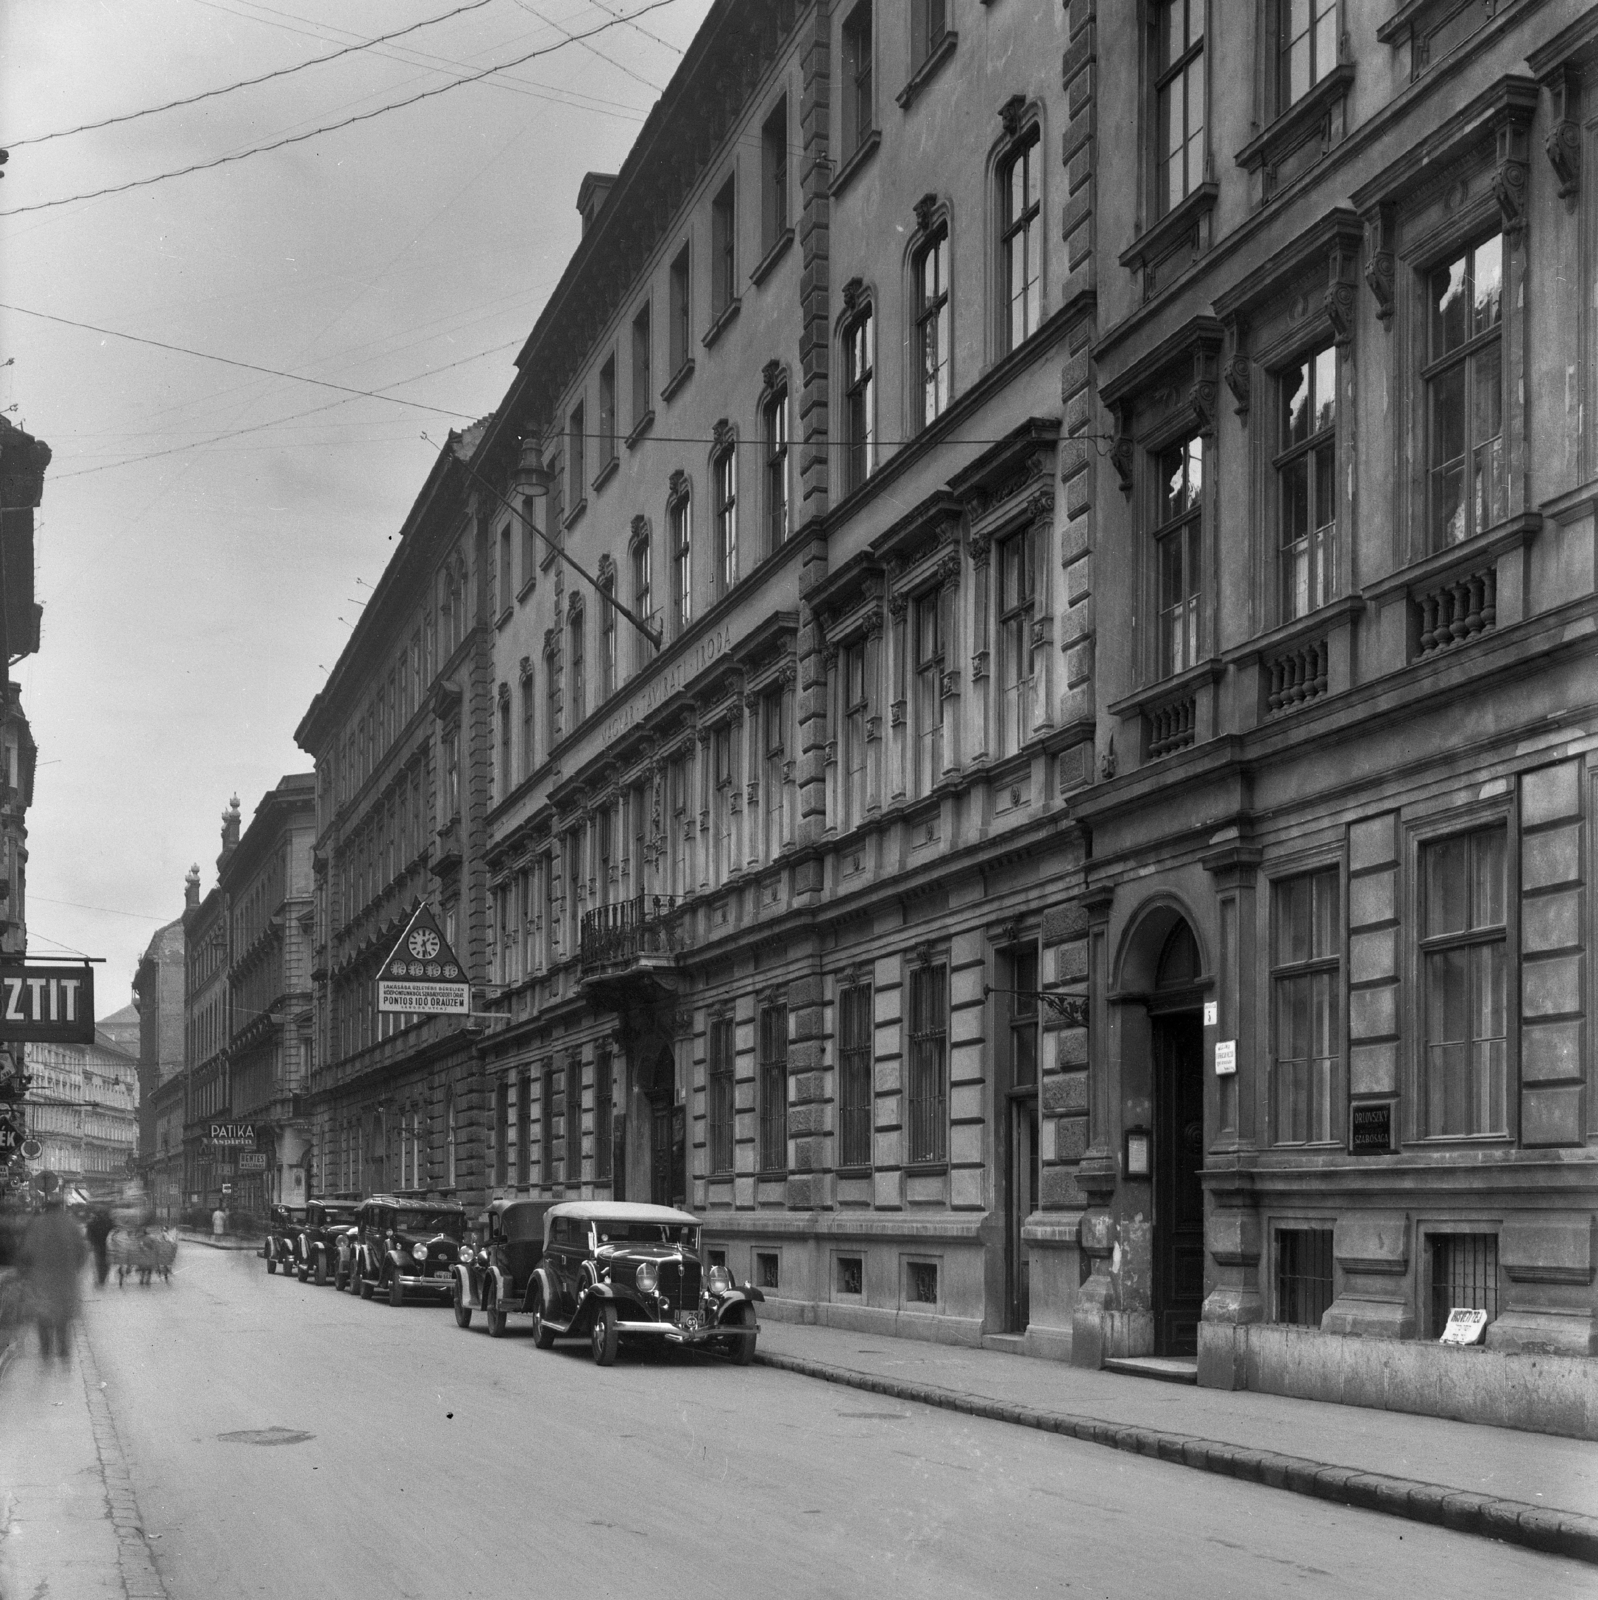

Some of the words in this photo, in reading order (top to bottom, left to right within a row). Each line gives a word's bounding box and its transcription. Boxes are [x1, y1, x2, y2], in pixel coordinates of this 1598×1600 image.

[601, 705, 633, 743] MAGYAR
[696, 625, 731, 671] IRODA
[0, 978, 81, 1021] ZTIT
[383, 996, 413, 1005] PONTOS
[211, 1124, 254, 1137] PATIKA
